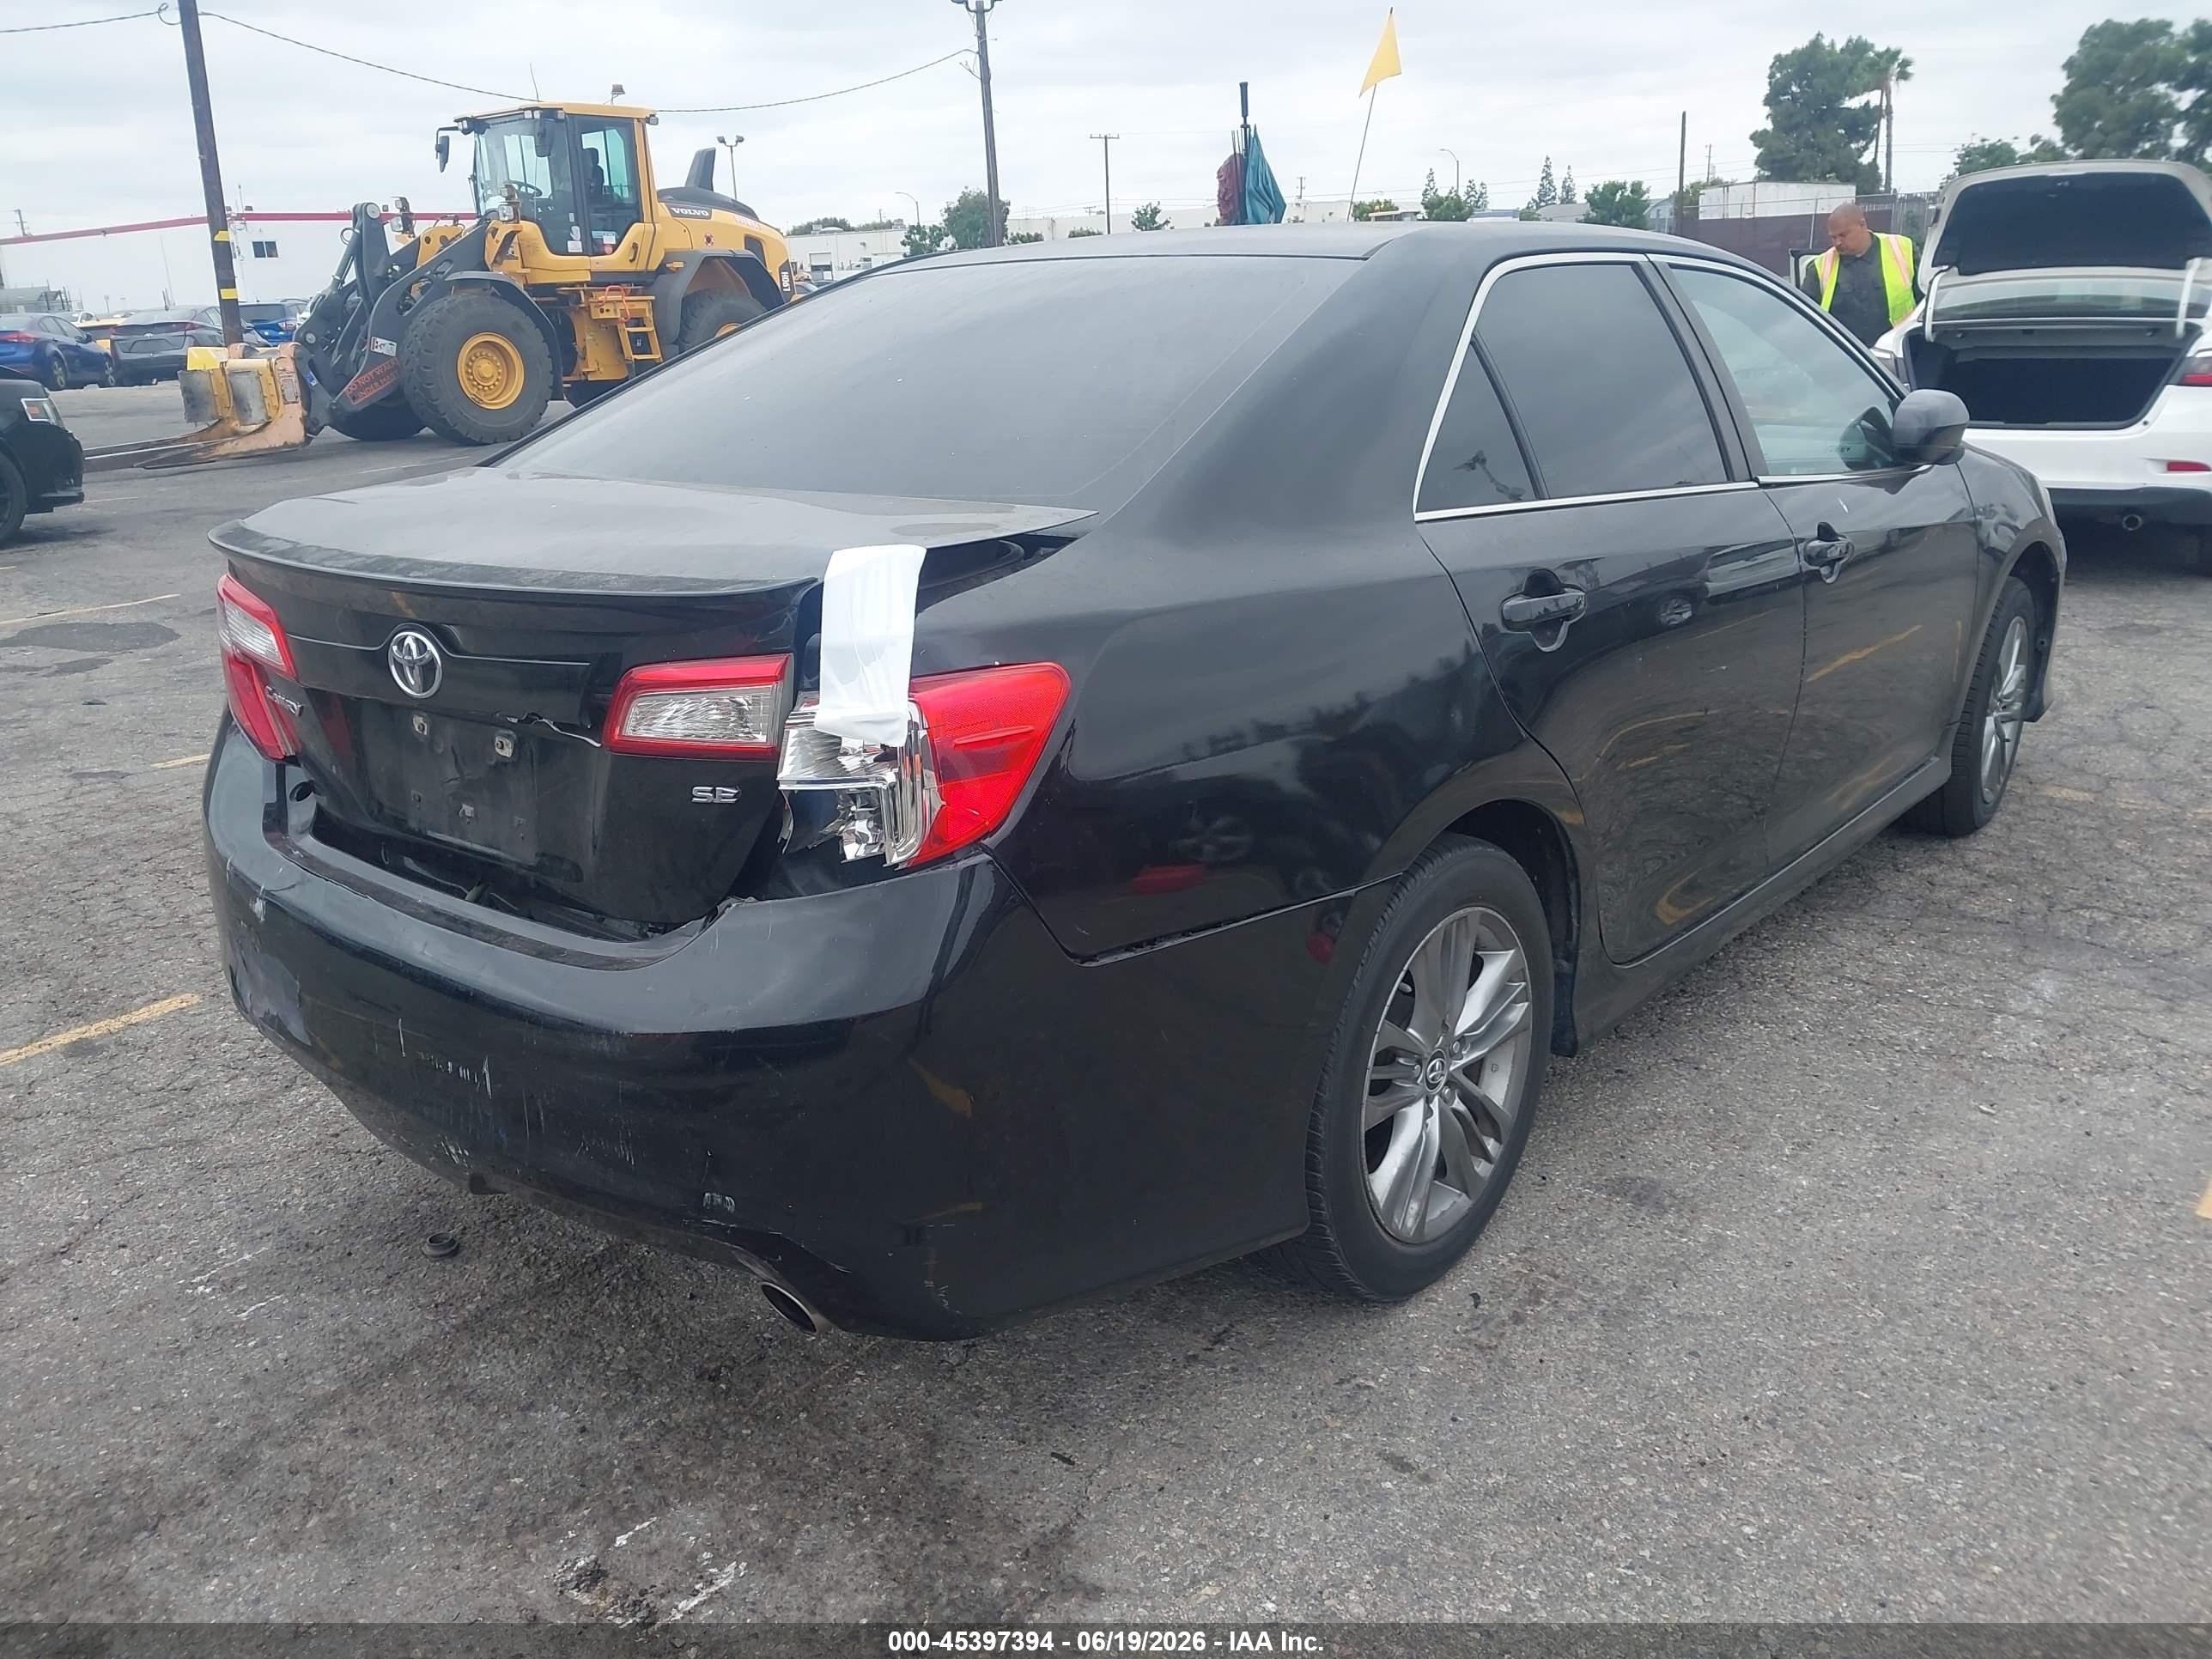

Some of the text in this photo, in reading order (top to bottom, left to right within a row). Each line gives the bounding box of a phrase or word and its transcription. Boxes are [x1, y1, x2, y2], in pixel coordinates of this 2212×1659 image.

[670, 207, 709, 216] VOLVO
[780, 271, 791, 292] L90H
[691, 786, 739, 803] SE
